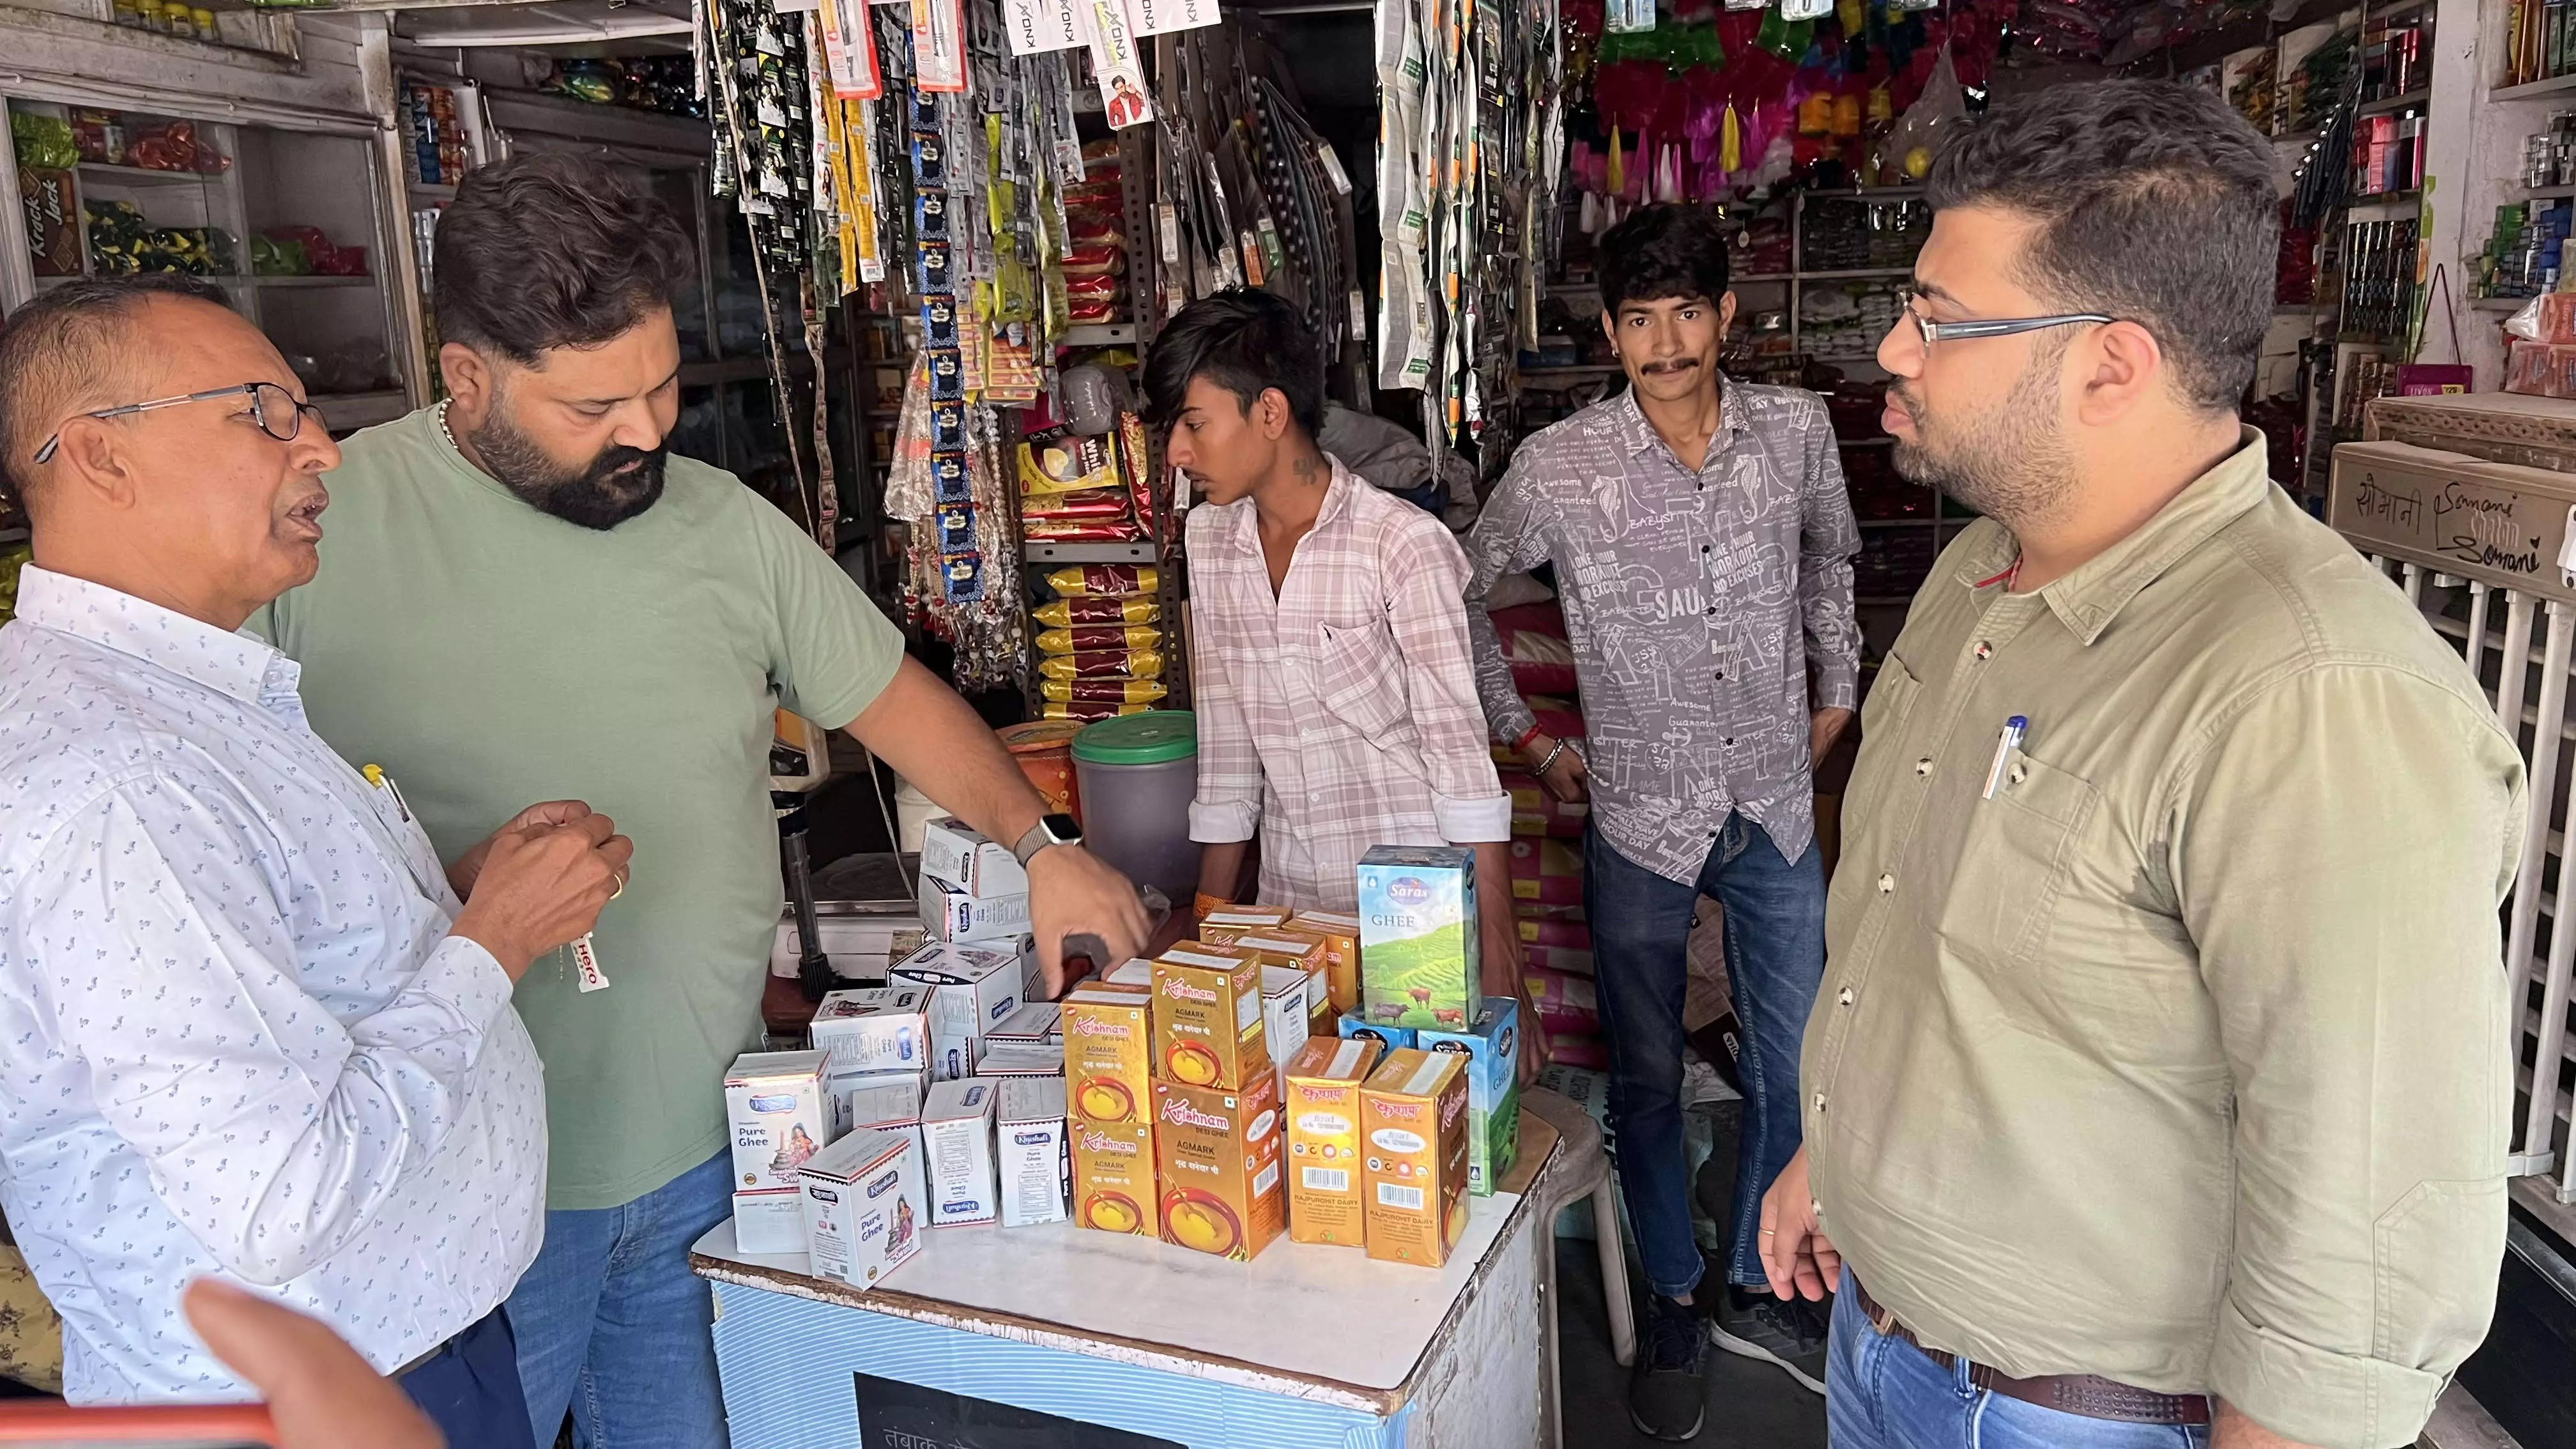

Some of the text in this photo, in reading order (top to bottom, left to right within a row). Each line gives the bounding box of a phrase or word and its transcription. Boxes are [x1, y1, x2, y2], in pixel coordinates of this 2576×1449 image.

[1016, 2, 1036, 48] KNOX
[1142, 0, 1155, 29] KNO
[1105, 11, 1127, 60] KNOX
[42, 179, 63, 226] Jack
[24, 196, 46, 257] Krack
[2356, 473, 2421, 535] सोमानी
[1601, 820, 1627, 842] HOUR
[1629, 838, 1652, 850] DAY
[1390, 883, 1429, 898] Saras
[1372, 914, 1415, 927] GHEE
[579, 944, 596, 984] Hero
[1162, 977, 1216, 1000] Krishnam
[1176, 1008, 1206, 1018] AGMARK
[1073, 1015, 1130, 1036] Krishnam
[1492, 1066, 1510, 1091] GHEE
[1161, 1098, 1229, 1130] Krishnam
[739, 1128, 766, 1136] Pure
[739, 1138, 769, 1147] Ghee
[1080, 1130, 1137, 1153] Krishnam
[1195, 1127, 1229, 1138] DESI GHEE
[1177, 1140, 1215, 1155] AGMARK
[1294, 1194, 1358, 1206] RAJPUROHIT DAIRY
[861, 1213, 881, 1230] Pure
[1370, 1210, 1412, 1223] RAJPUROHIT
[862, 1223, 884, 1241] Ghee
